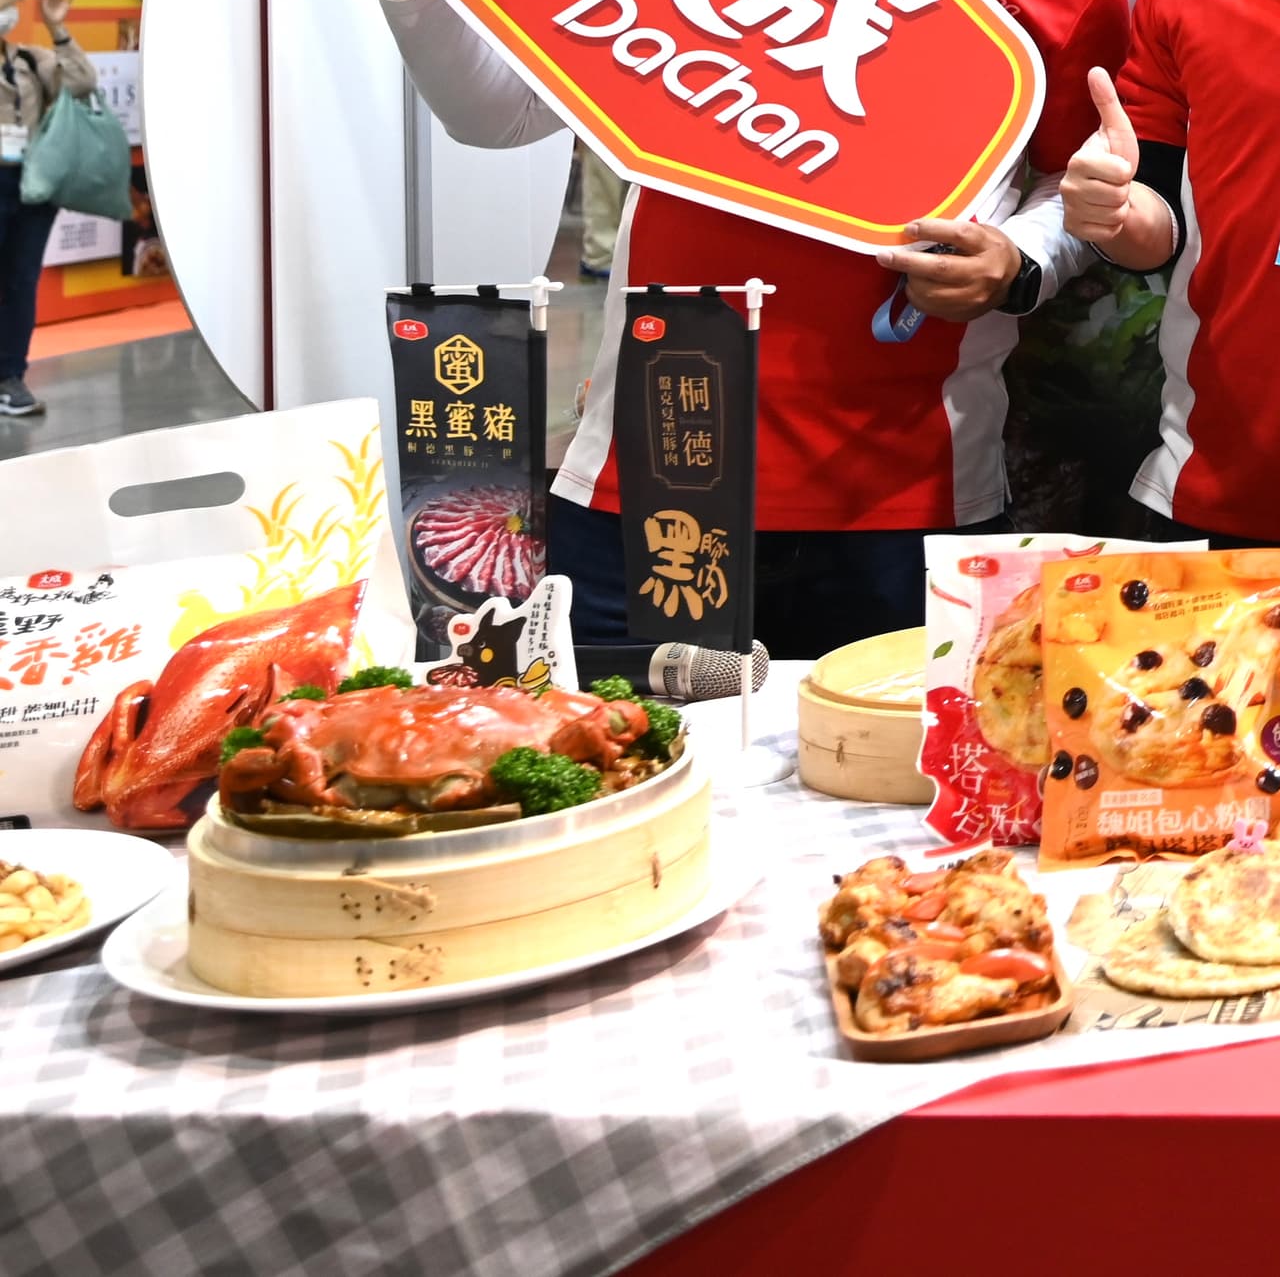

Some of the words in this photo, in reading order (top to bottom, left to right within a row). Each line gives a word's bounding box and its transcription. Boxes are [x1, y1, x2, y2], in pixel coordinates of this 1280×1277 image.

[404, 398, 517, 443] 黑蜜豬
[678, 375, 713, 468] 桐德
